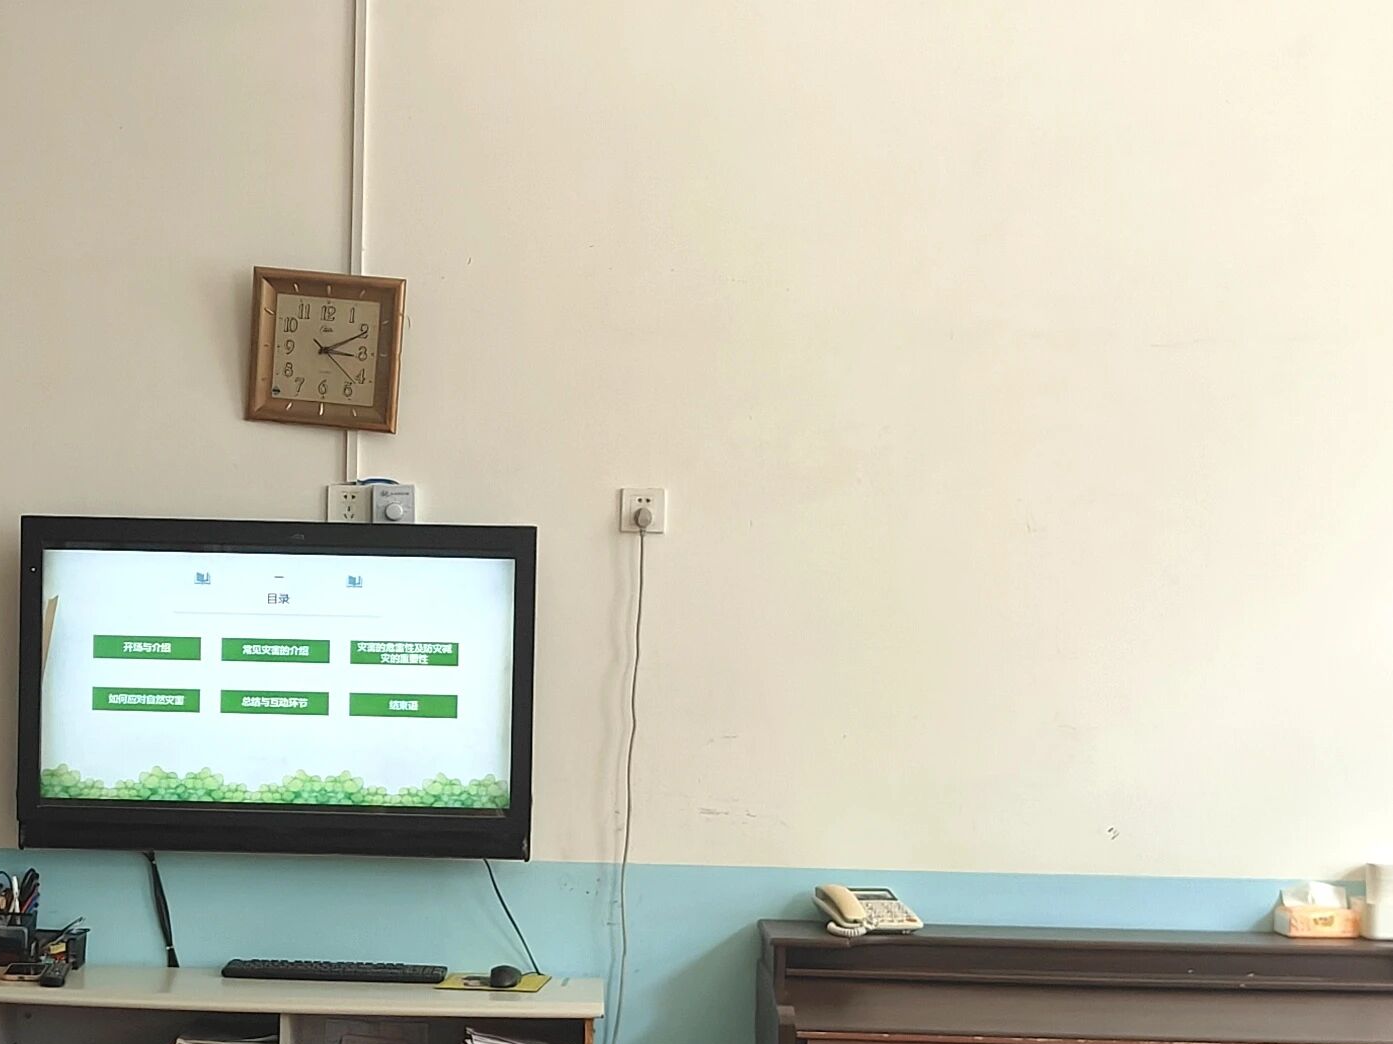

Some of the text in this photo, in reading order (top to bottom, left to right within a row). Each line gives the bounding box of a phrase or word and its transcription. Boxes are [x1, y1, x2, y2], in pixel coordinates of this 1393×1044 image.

[298, 303, 311, 319] 11
[320, 306, 336, 321] 12
[349, 307, 355, 323] 1
[284, 317, 298, 333] 10
[360, 324, 369, 339] 2
[284, 340, 294, 354] 9
[358, 346, 367, 361] 3
[284, 362, 293, 377] 8
[355, 368, 366, 384] 4
[294, 377, 304, 392] 7
[318, 380, 327, 395] 6
[344, 382, 352, 397] 5
[267, 592, 290, 605] 目录
[123, 641, 171, 653] 开场与介绍
